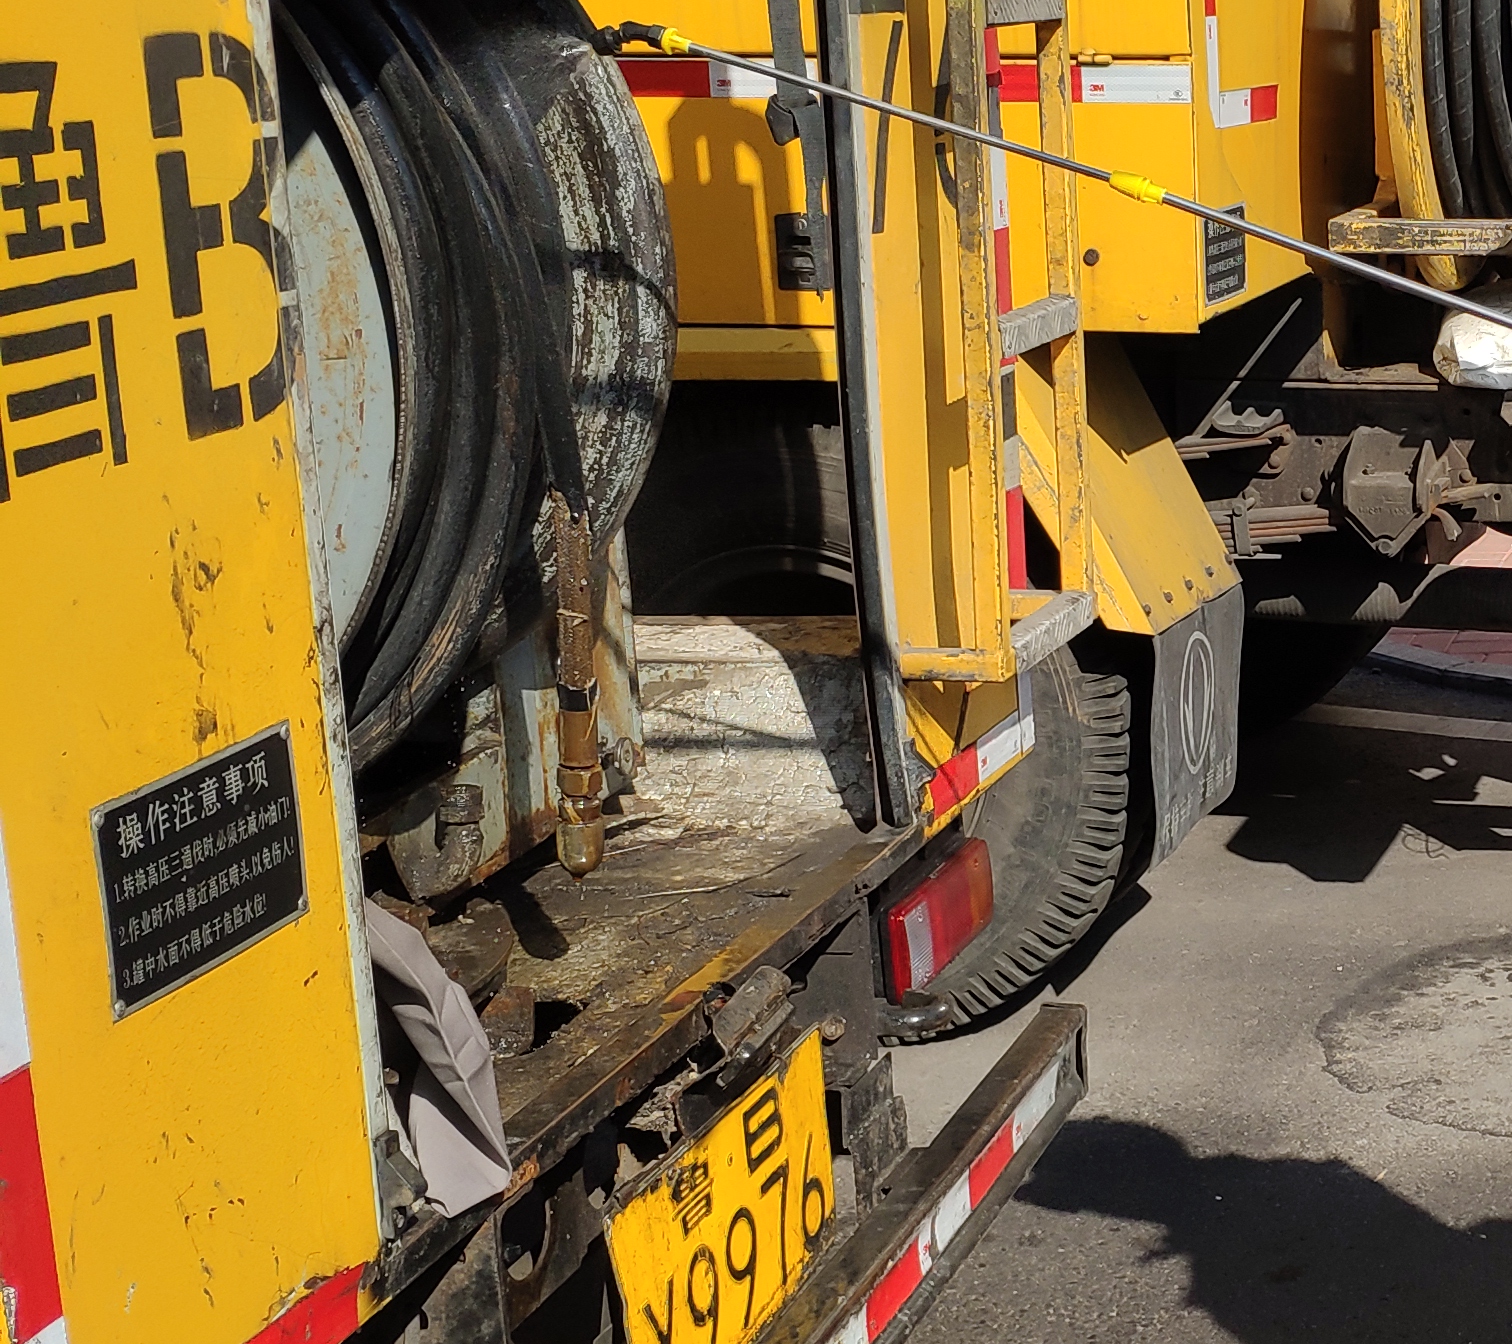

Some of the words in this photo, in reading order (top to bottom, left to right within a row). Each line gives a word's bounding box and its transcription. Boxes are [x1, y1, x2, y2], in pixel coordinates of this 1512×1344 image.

[716, 79, 732, 88] 3M
[1089, 84, 1105, 93] 3M
[0, 31, 300, 504] 鲁B
[115, 750, 270, 859] 操作注意事项
